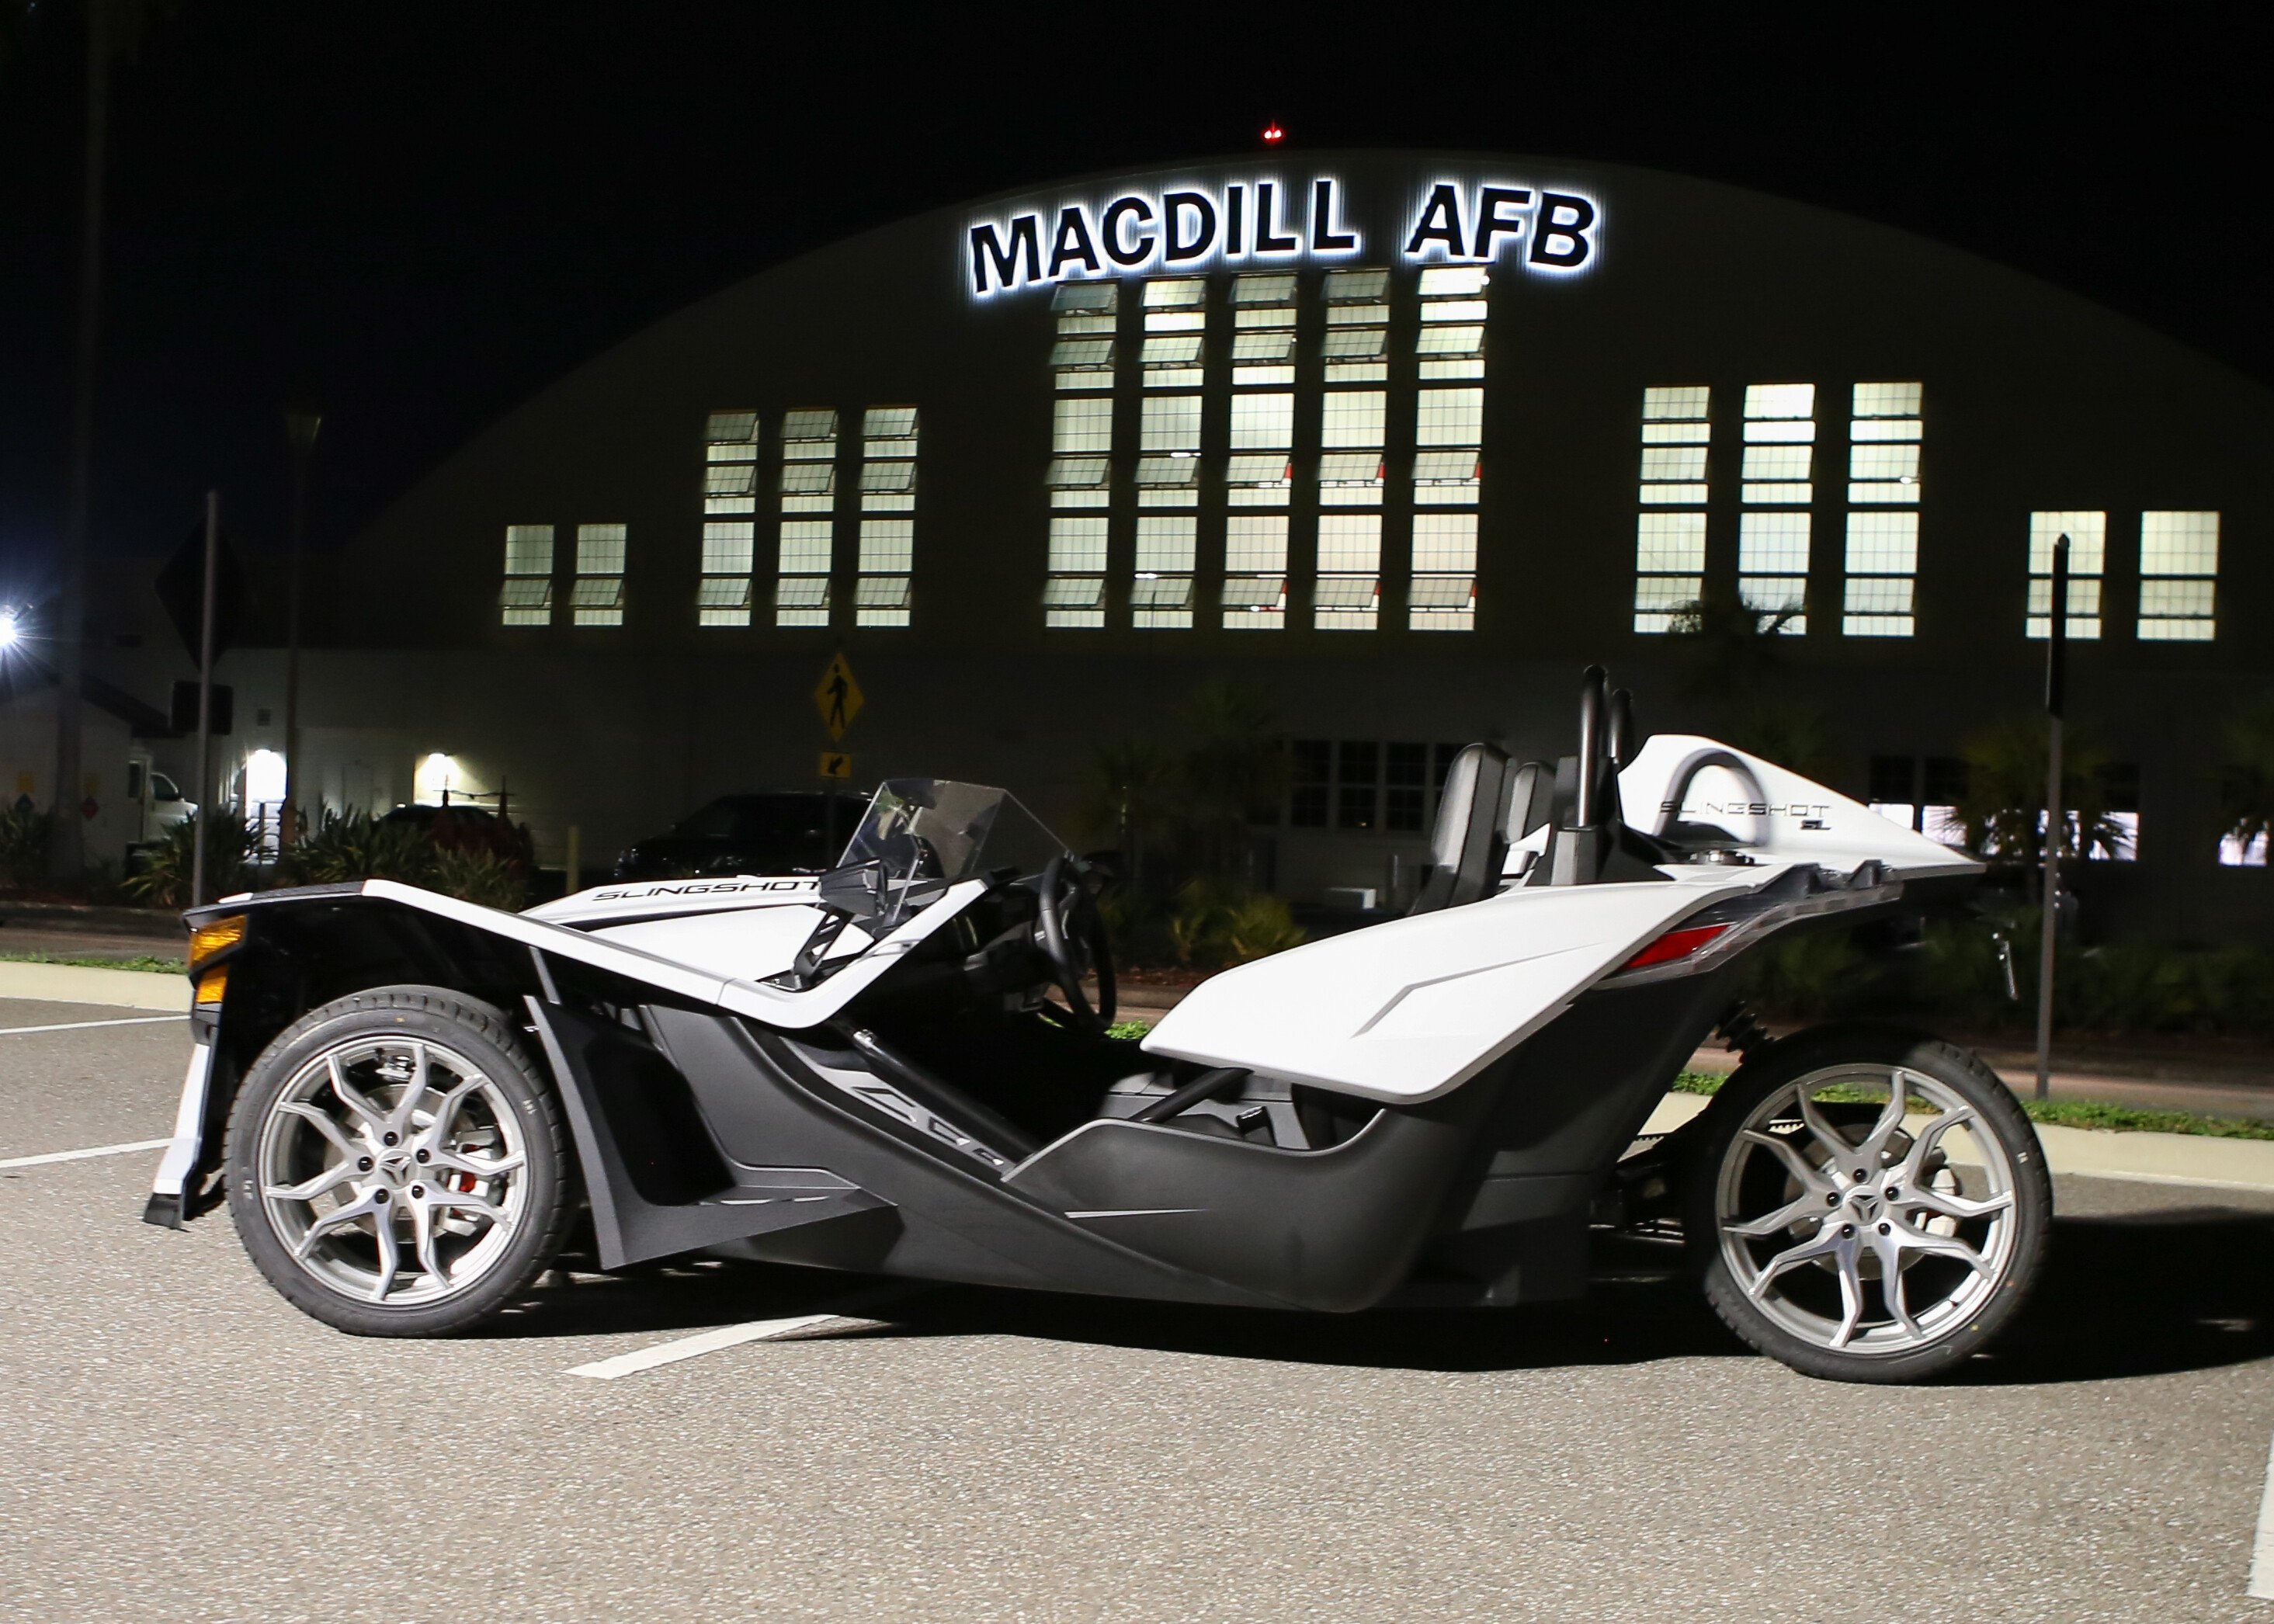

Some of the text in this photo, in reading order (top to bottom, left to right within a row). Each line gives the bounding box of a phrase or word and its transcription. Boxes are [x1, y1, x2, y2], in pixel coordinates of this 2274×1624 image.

[970, 179, 1595, 293] MACDILL AFB
[1660, 800, 1832, 817] SLINGSHOT
[592, 881, 819, 901] SLINGSHOT
